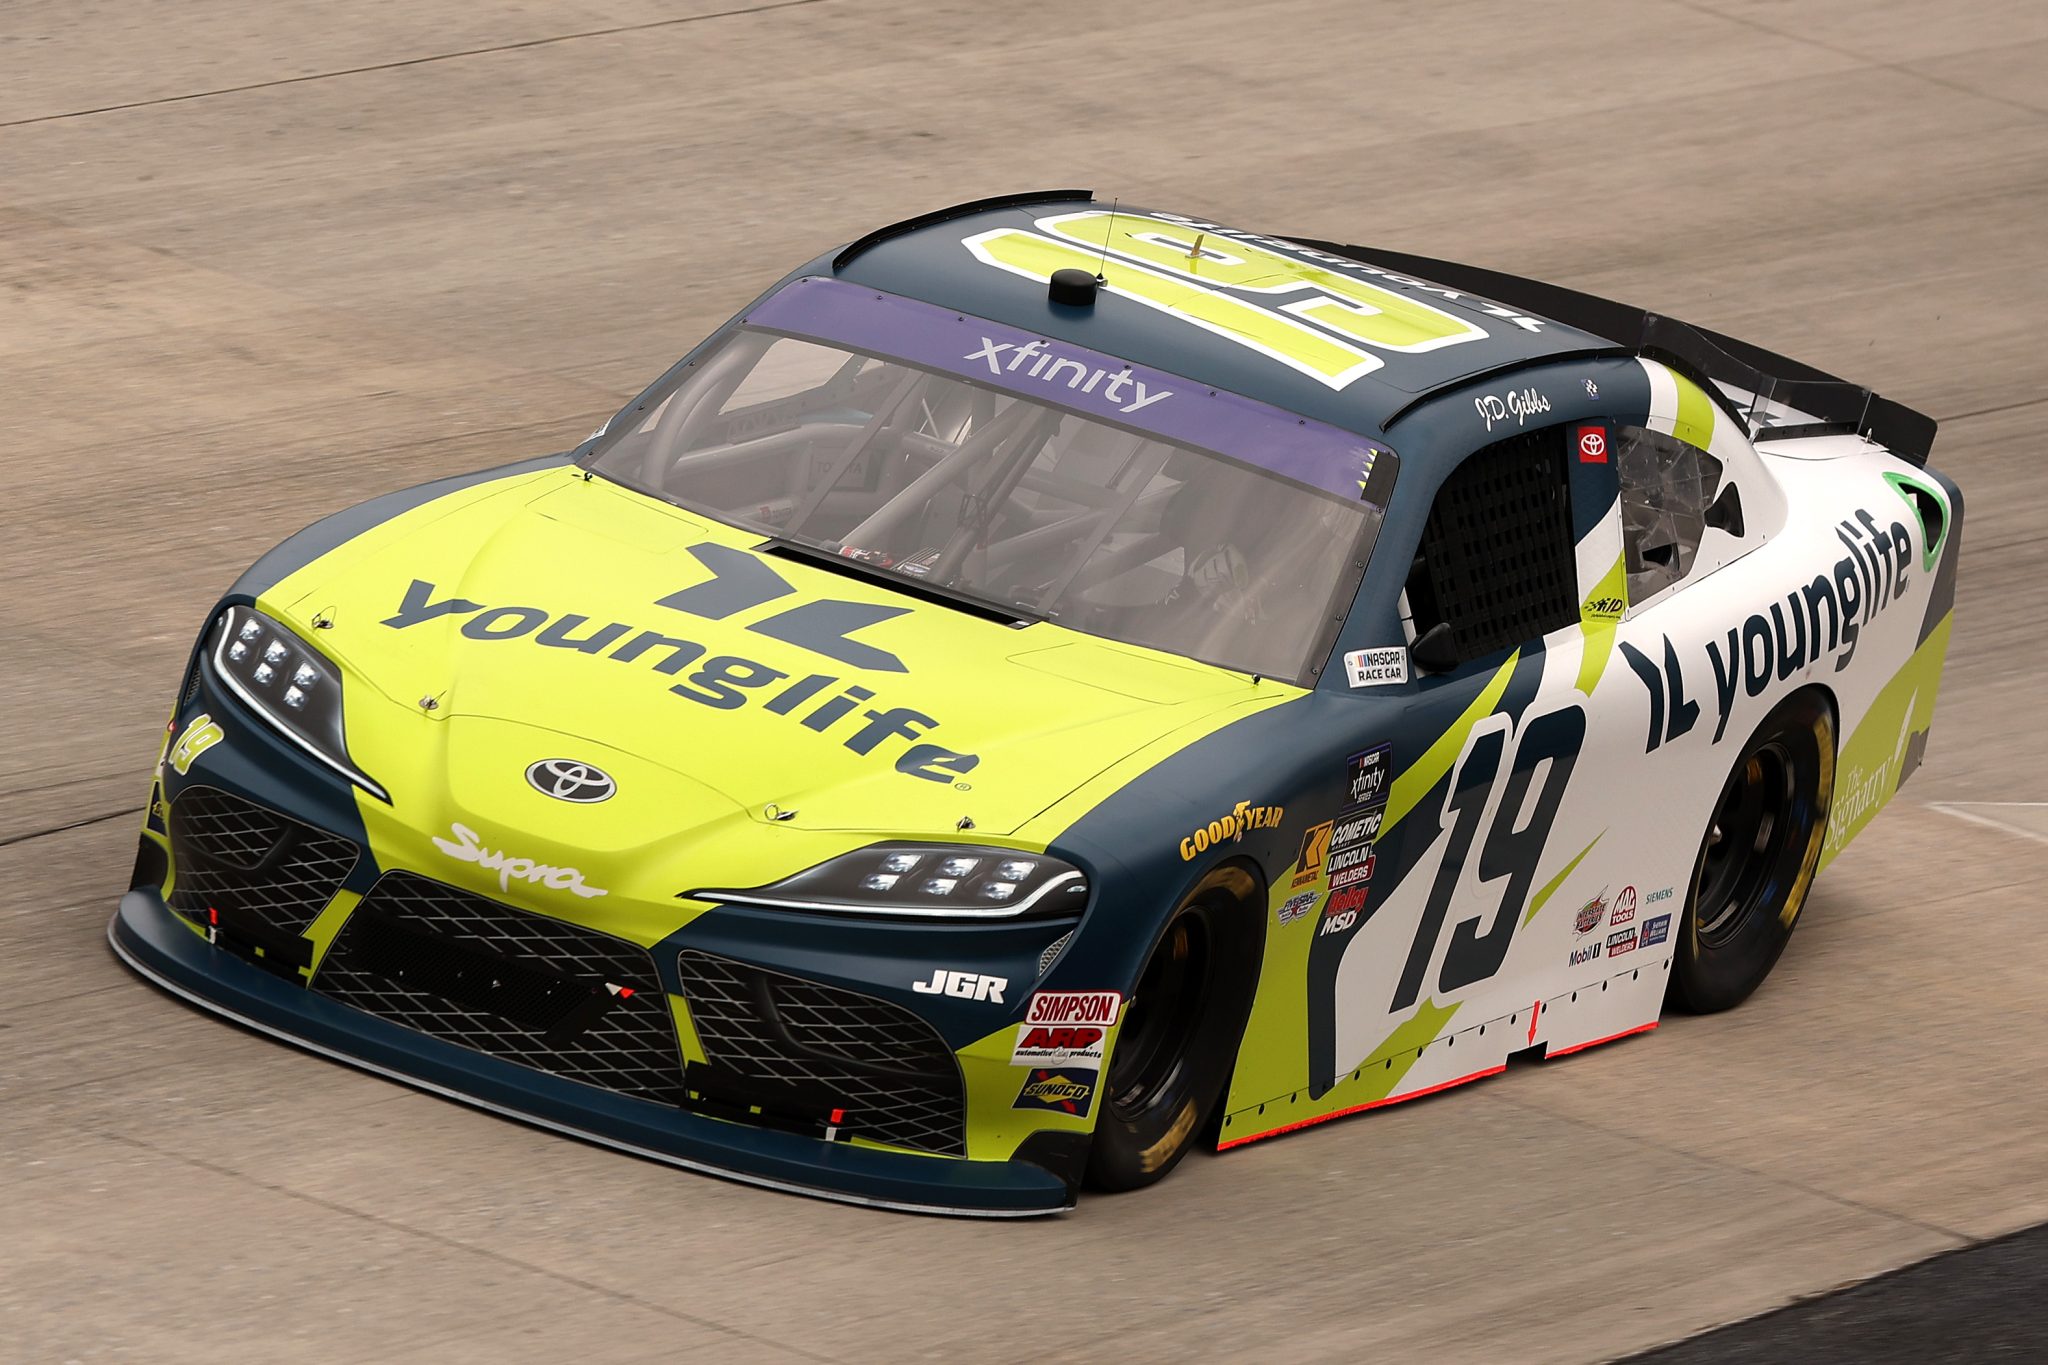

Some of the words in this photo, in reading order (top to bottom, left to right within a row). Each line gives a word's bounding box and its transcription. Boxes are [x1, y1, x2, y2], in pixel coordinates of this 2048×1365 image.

[963, 336, 1174, 413] xfinity
[1475, 395, 1509, 432] J.D.
[1507, 387, 1551, 426] Gibbs
[1705, 508, 1912, 746] younglife
[1366, 651, 1401, 667] NASCAR
[378, 579, 980, 784] younglife
[1358, 669, 1383, 681] RACE
[1385, 667, 1402, 679] CAR
[168, 713, 225, 776] 19
[1363, 751, 1380, 767] NASCAR
[1350, 765, 1386, 800] xfinity
[1179, 799, 1284, 862] GOODYEAR
[1331, 813, 1382, 846] COMETIC
[431, 822, 609, 898] Supra
[1327, 845, 1371, 873] LINCOLN
[1388, 704, 1587, 1014] 19
[1332, 865, 1369, 887] WELDERS
[1645, 887, 1675, 905] SIEMENS
[1320, 909, 1358, 937] MSD
[1612, 909, 1635, 925] TOOLS
[1607, 928, 1636, 946] LINCOLN
[1611, 941, 1635, 956] WELDERS
[1568, 945, 1593, 968] Mobil
[912, 969, 1008, 1004] JGR
[1031, 995, 1114, 1022] SIMPSON
[1018, 1027, 1103, 1049] ARP
[1068, 1050, 1102, 1058] products
[1027, 1083, 1085, 1099] SUNOCO
